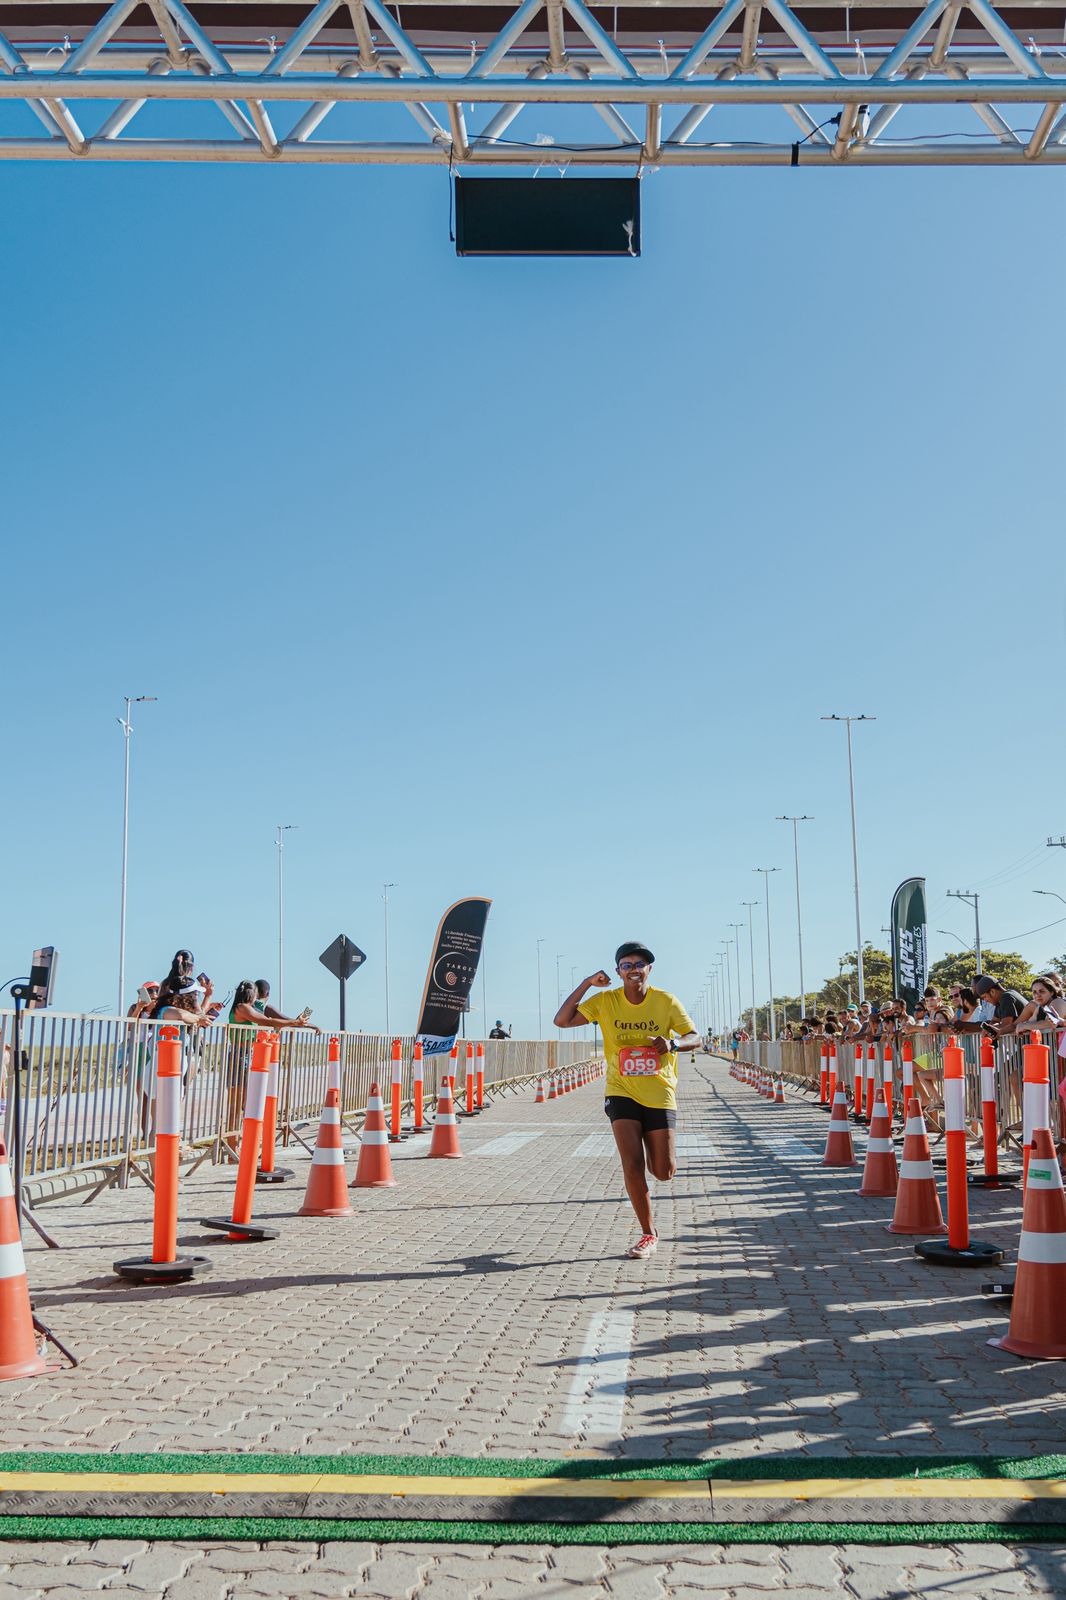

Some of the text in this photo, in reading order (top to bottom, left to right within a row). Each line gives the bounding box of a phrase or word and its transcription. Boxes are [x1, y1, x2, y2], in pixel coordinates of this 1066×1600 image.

[913, 926, 922, 938] ES
[899, 927, 915, 989] SAPES
[446, 963, 478, 972] TARGET
[624, 1059, 656, 1071] 059
